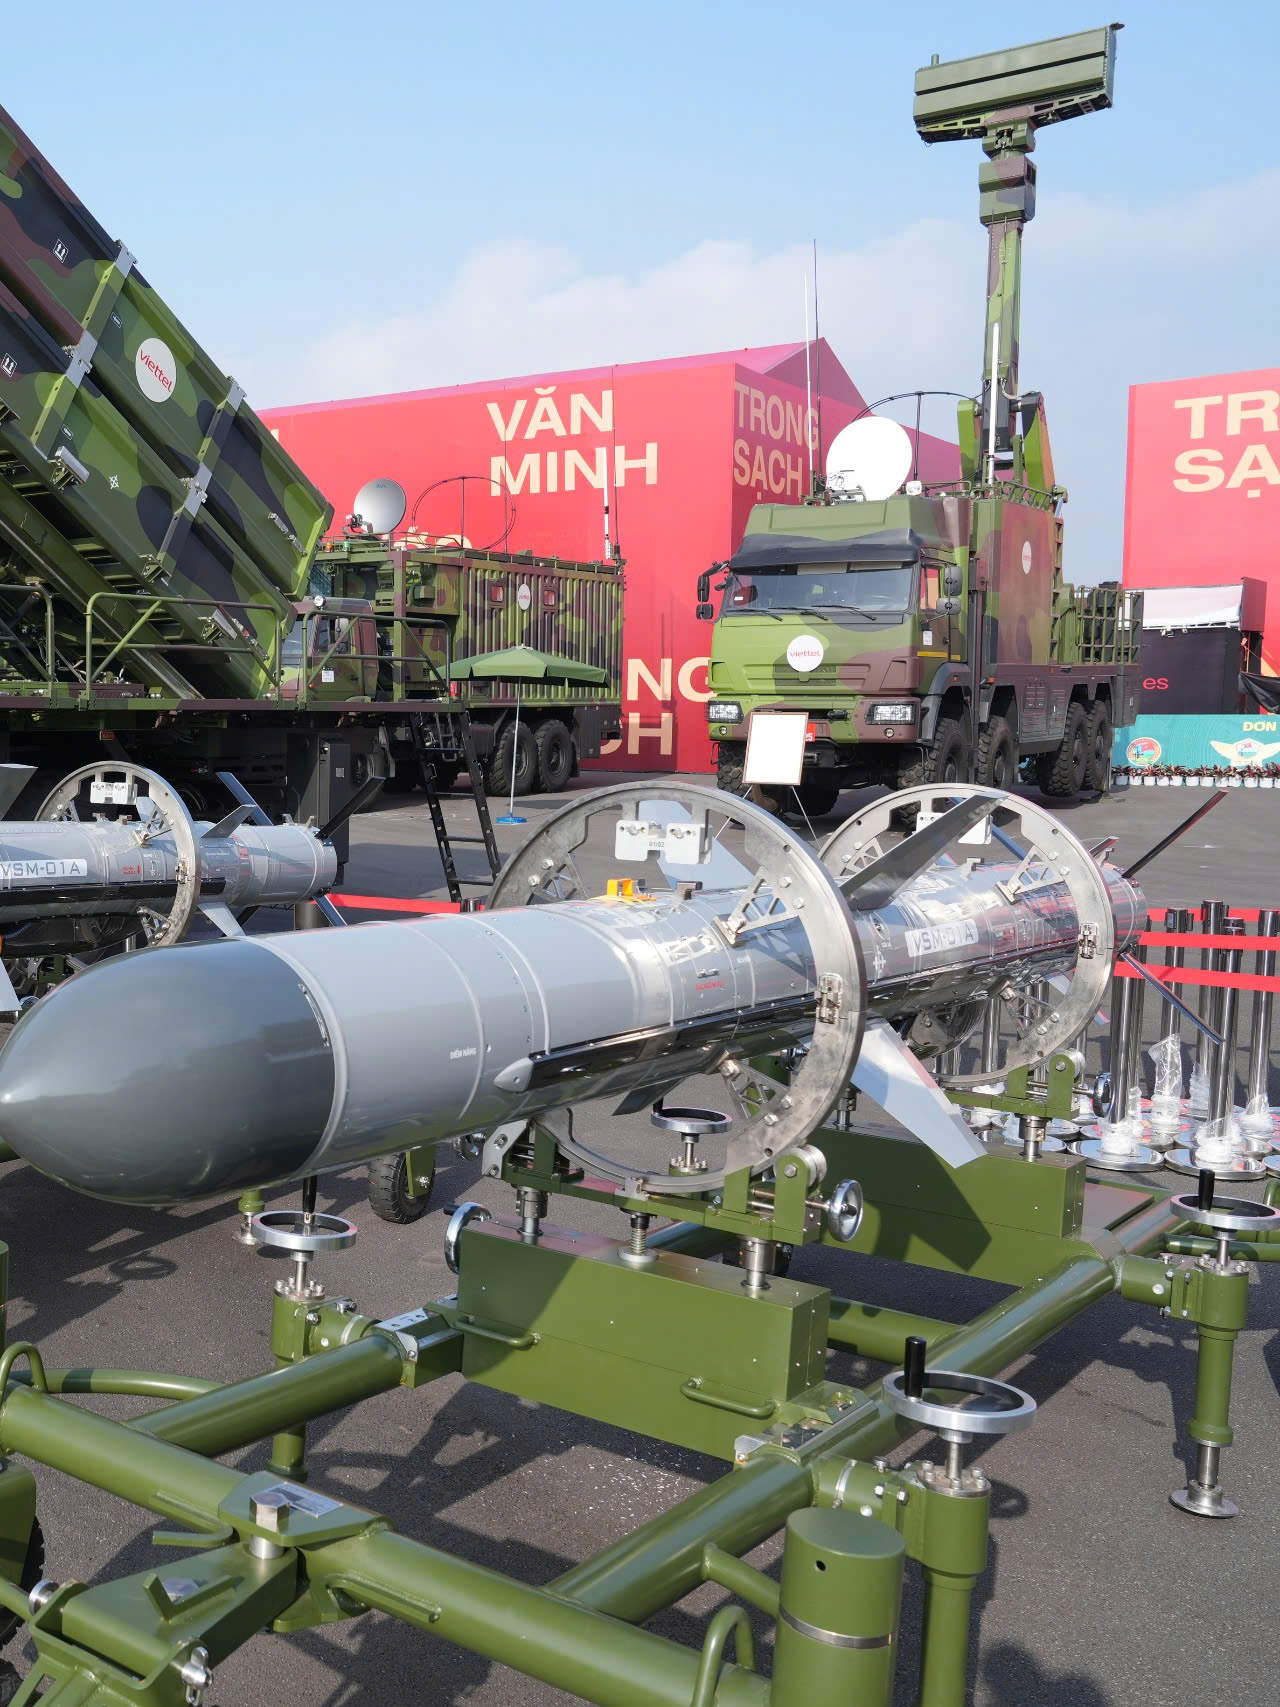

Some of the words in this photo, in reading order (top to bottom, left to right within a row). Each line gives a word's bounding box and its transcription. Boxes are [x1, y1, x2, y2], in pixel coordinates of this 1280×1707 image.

[140, 349, 172, 393] viettel
[486, 386, 613, 442] VĂN
[734, 381, 819, 451] TRONG
[490, 442, 658, 497] MINH
[733, 438, 803, 502] SẠCH
[0, 861, 81, 877] VSM-01A
[912, 922, 975, 954] VSM-01A
